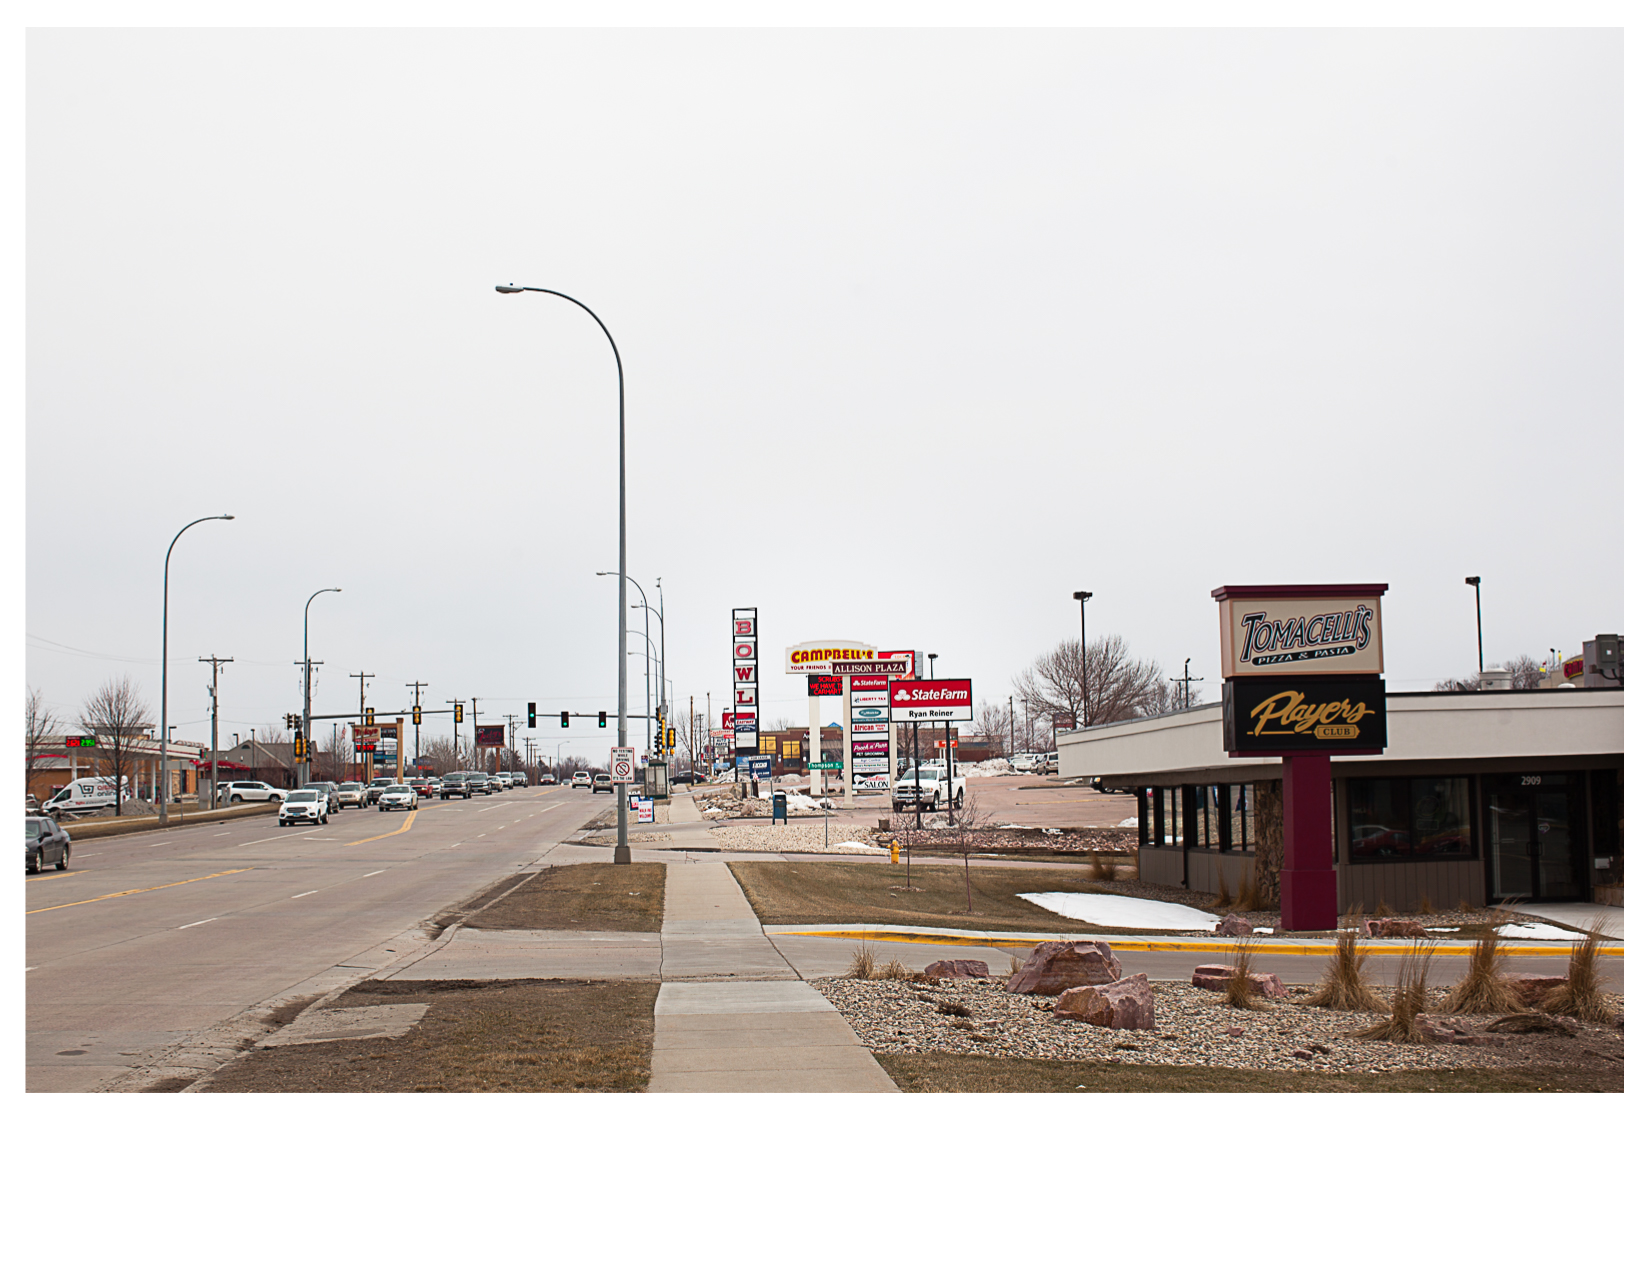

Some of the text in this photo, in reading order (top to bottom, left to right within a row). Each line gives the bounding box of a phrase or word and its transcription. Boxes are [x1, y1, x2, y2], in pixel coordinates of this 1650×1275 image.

[1240, 605, 1374, 663] TOMACELLI'S
[735, 620, 754, 704] BOWL
[790, 647, 874, 664] CAMPBELL'S
[1258, 646, 1349, 665] PIZZA & PASTA
[834, 663, 905, 673] ALLISON PLAZA
[908, 709, 953, 719] Ryan Reiner
[1250, 690, 1376, 737] Players
[1323, 728, 1351, 736] CLUB
[864, 781, 889, 789] SALON
[1520, 776, 1542, 786] 2909
